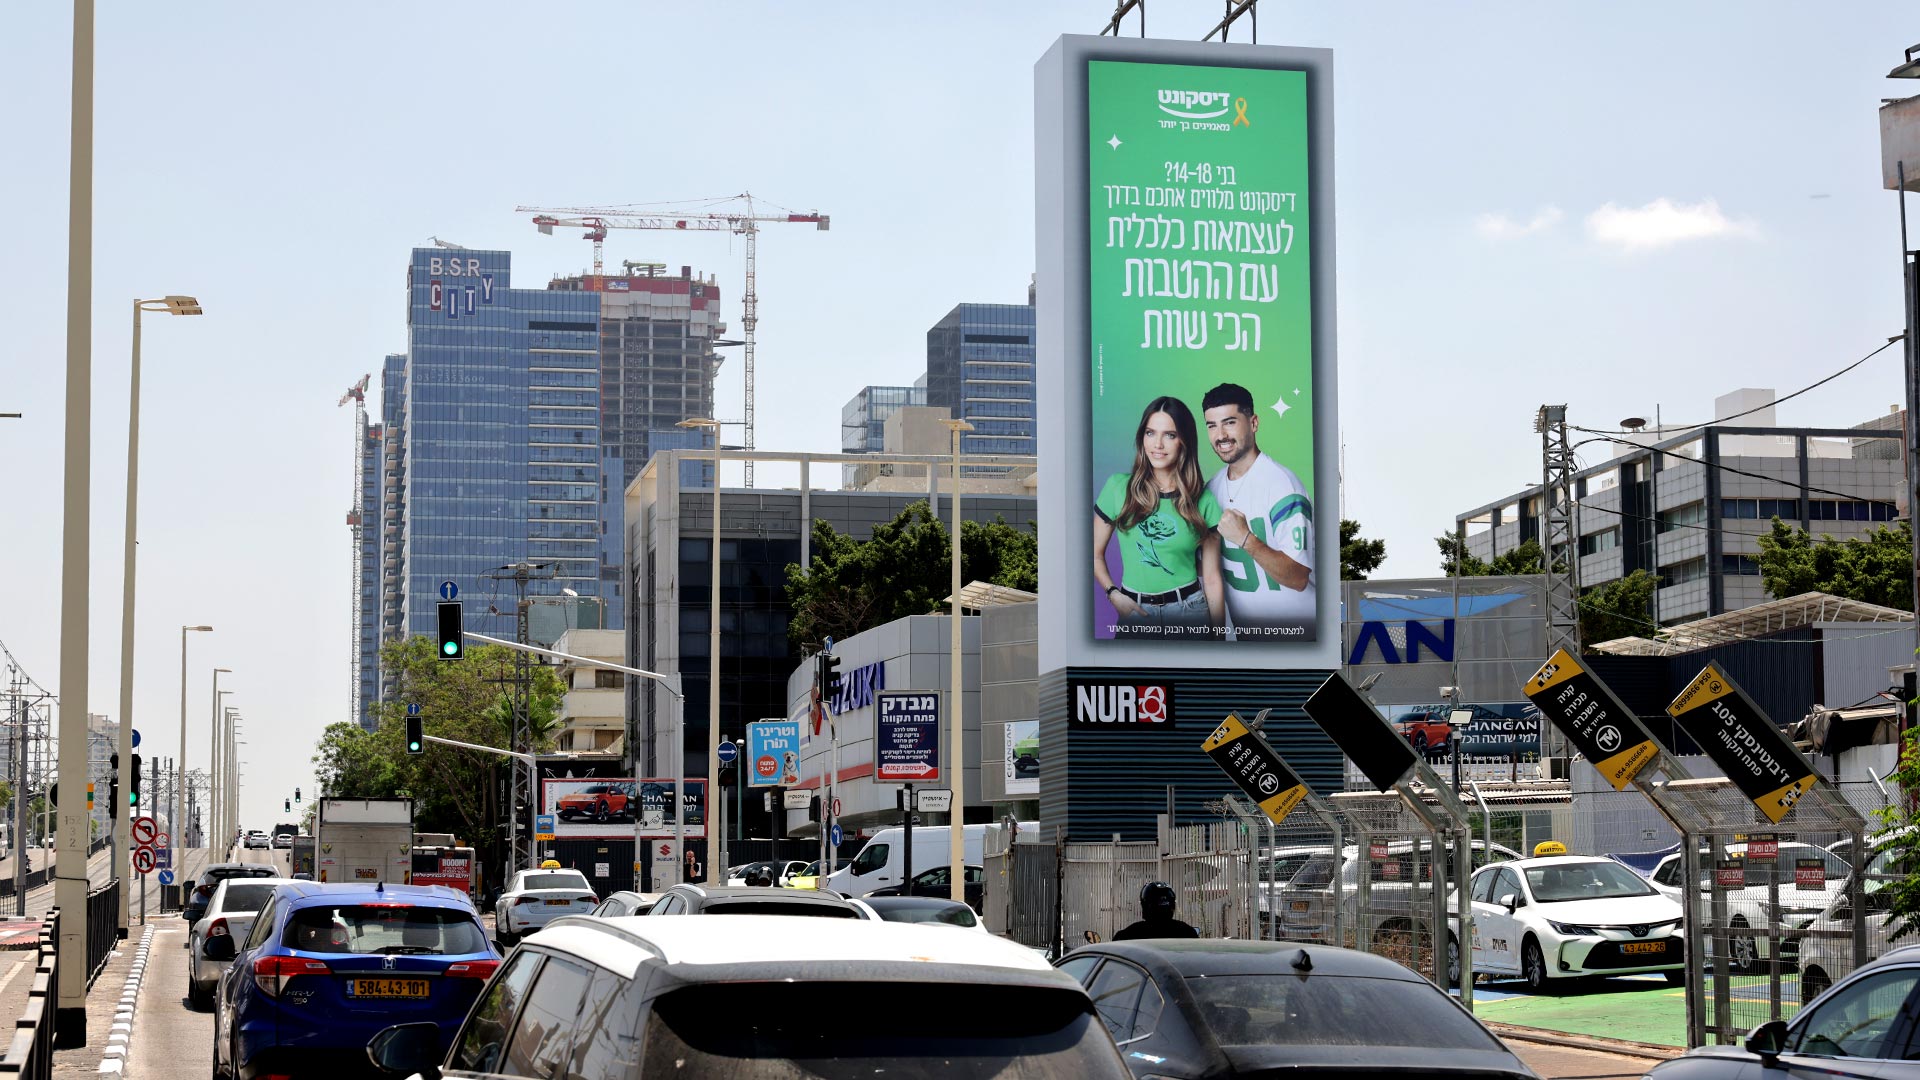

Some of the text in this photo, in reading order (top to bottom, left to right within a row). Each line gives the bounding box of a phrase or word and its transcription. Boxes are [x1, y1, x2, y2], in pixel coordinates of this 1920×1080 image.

[1158, 89, 1230, 109] דיסקונט
[1158, 120, 1230, 132] מאמינים בך יותר
[1216, 166, 1236, 185] בני
[1103, 185, 1296, 215] דיסקונט מלווים אתכם בדרך
[1106, 212, 1294, 254] לעצמאות כלכלית
[430, 257, 480, 277] B.S.R
[1122, 258, 1279, 302] עם ההטבות
[431, 278, 493, 316] CITY
[1141, 309, 1261, 351] הכי שוות
[1107, 625, 1130, 633] באתר
[1132, 625, 1162, 633] כמפורט
[1164, 625, 1184, 635] הבנק
[1187, 625, 1210, 634] לתנאי
[1212, 627, 1231, 636] כפוף
[1264, 626, 1305, 636] למצטרפים
[1538, 664, 1557, 684] TAXI
[822, 661, 884, 718] UZUKI
[1557, 684, 1575, 704] קניה
[882, 697, 935, 715] מבדק
[1077, 685, 1137, 722] NUR
[1564, 692, 1588, 717] מכירה
[882, 714, 936, 724] פתח תקווה
[1572, 701, 1599, 728] השכרה
[1712, 701, 1737, 727] 105
[756, 727, 795, 736] וטרינר
[1582, 710, 1607, 739] טרייד אין
[1461, 732, 1537, 744] למי שרוצה הכל
[1228, 742, 1242, 758] קניה
[1234, 748, 1252, 768] מכירה
[1717, 729, 1762, 777] פתח תקווה
[1240, 754, 1261, 776] השכרה
[1765, 843, 1777, 852] שלם
